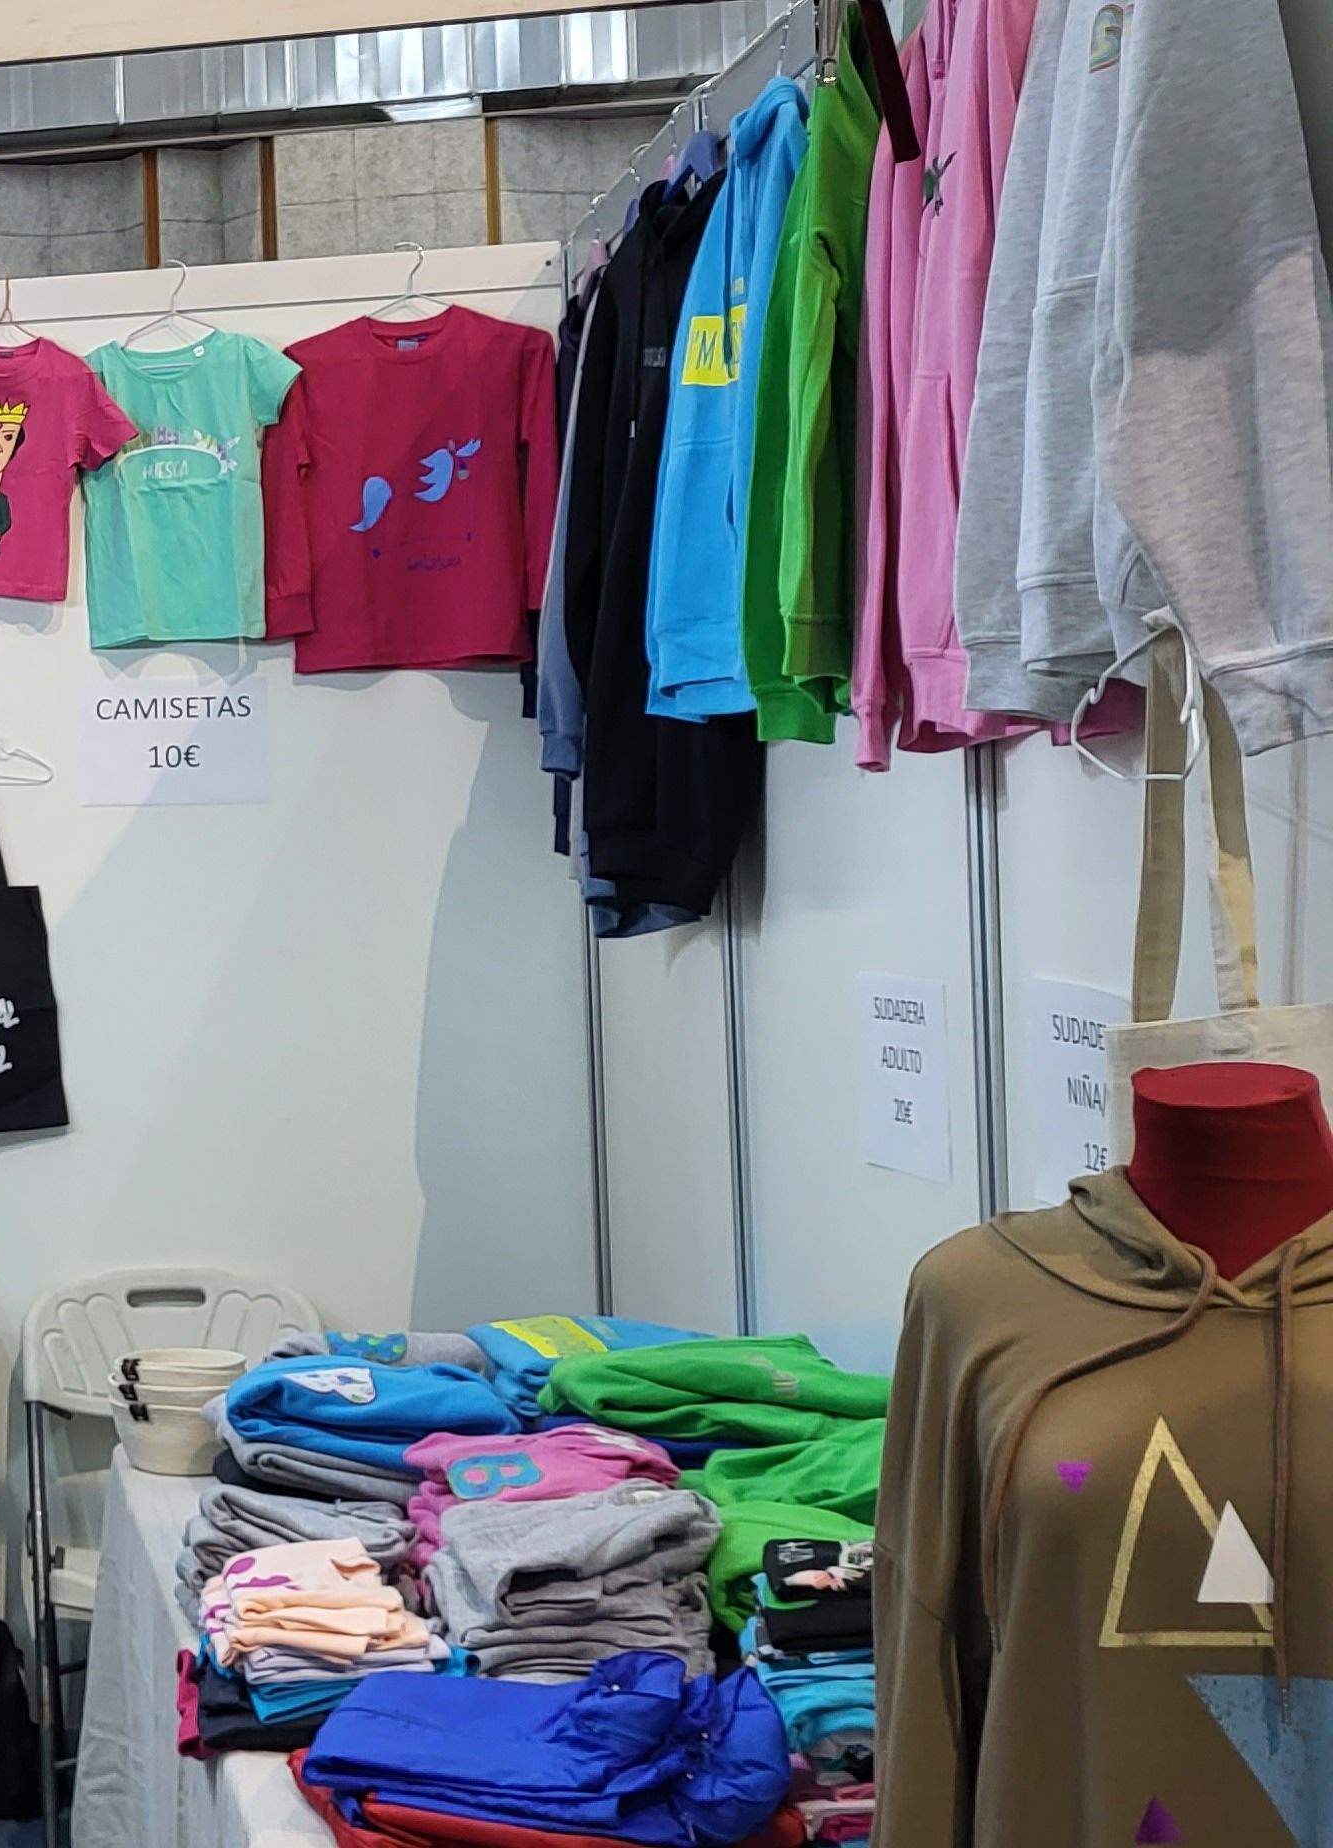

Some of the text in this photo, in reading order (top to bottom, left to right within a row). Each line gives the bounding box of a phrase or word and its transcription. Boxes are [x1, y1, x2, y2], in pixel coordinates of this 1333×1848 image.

[95, 695, 251, 722] CAMISETAS
[148, 743, 201, 770] 10€
[873, 996, 926, 1026] SUDADERA
[1052, 1014, 1106, 1051] SUDADE
[881, 1045, 923, 1074] ADULTO
[1067, 1074, 1107, 1118] NIÑA/
[1085, 1142, 1108, 1173] 12€
